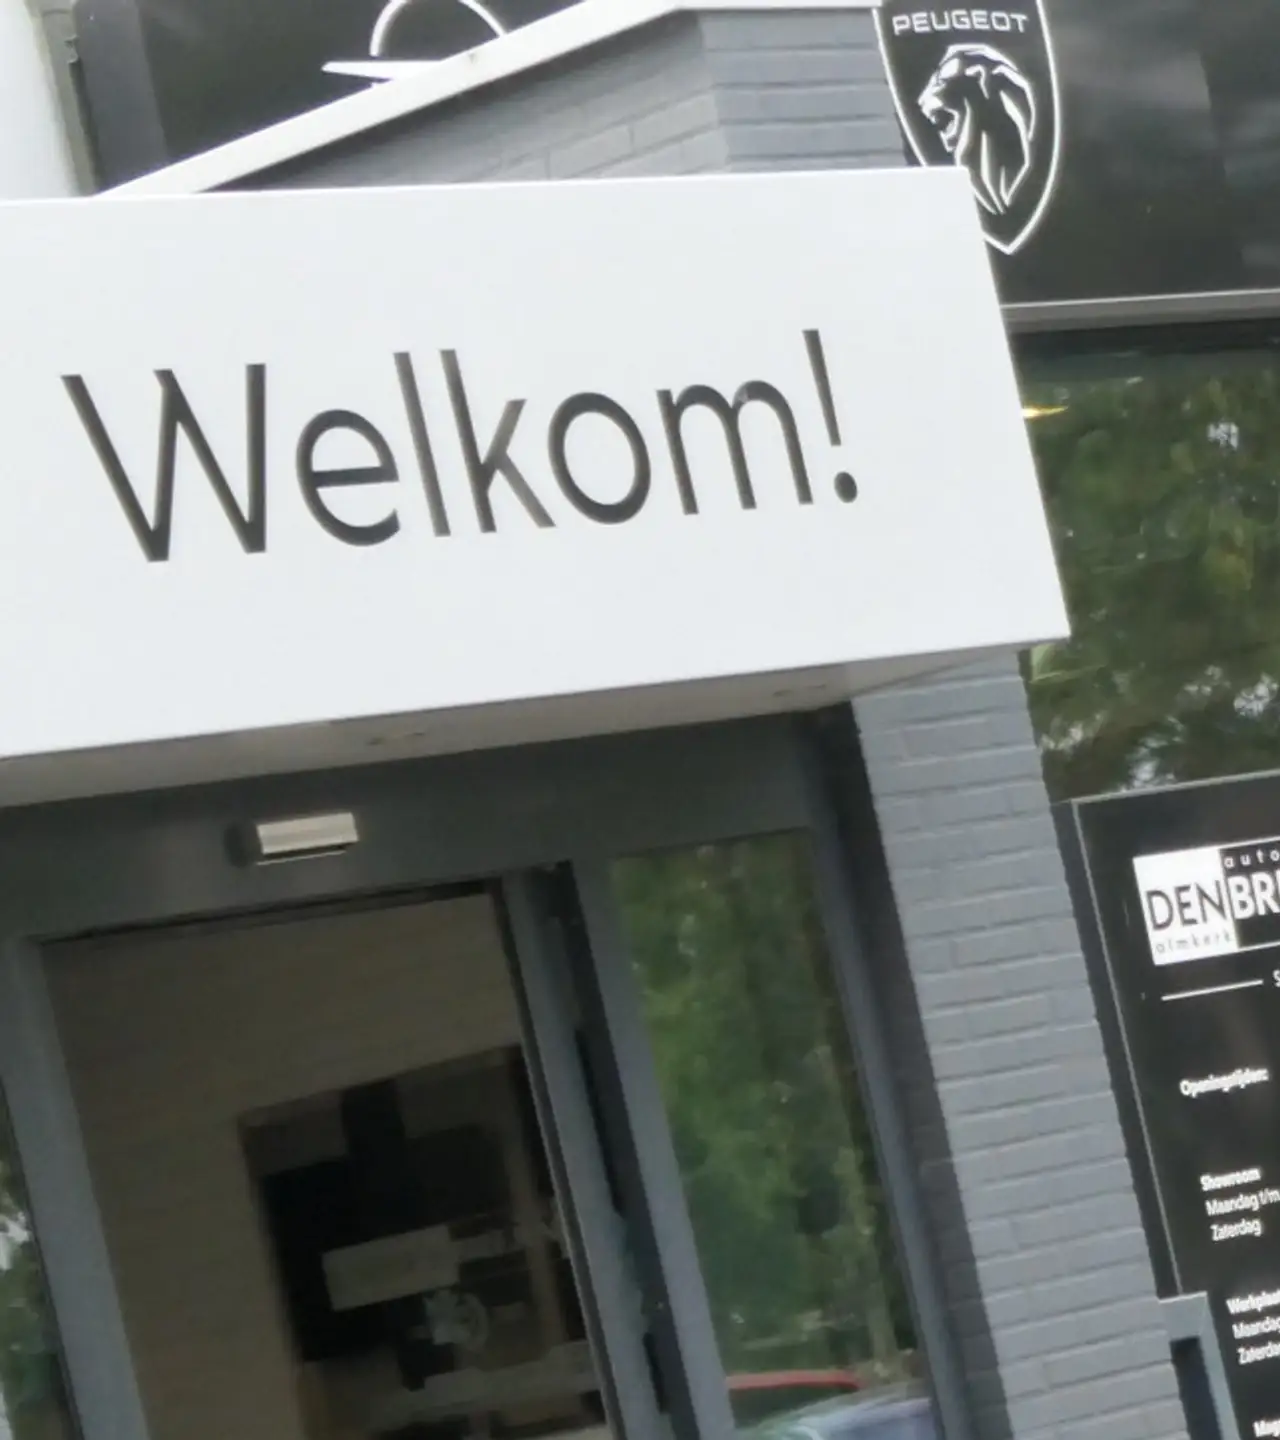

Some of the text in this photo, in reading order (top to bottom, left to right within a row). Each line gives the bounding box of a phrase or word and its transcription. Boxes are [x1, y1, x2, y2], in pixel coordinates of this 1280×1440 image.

[892, 9, 1029, 36] PEUGEOT
[60, 328, 859, 564] Welkom!
[1200, 1167, 1262, 1192] Showroom
[1205, 1193, 1260, 1216] Maandag
[1210, 1218, 1262, 1242] Zaterdag
